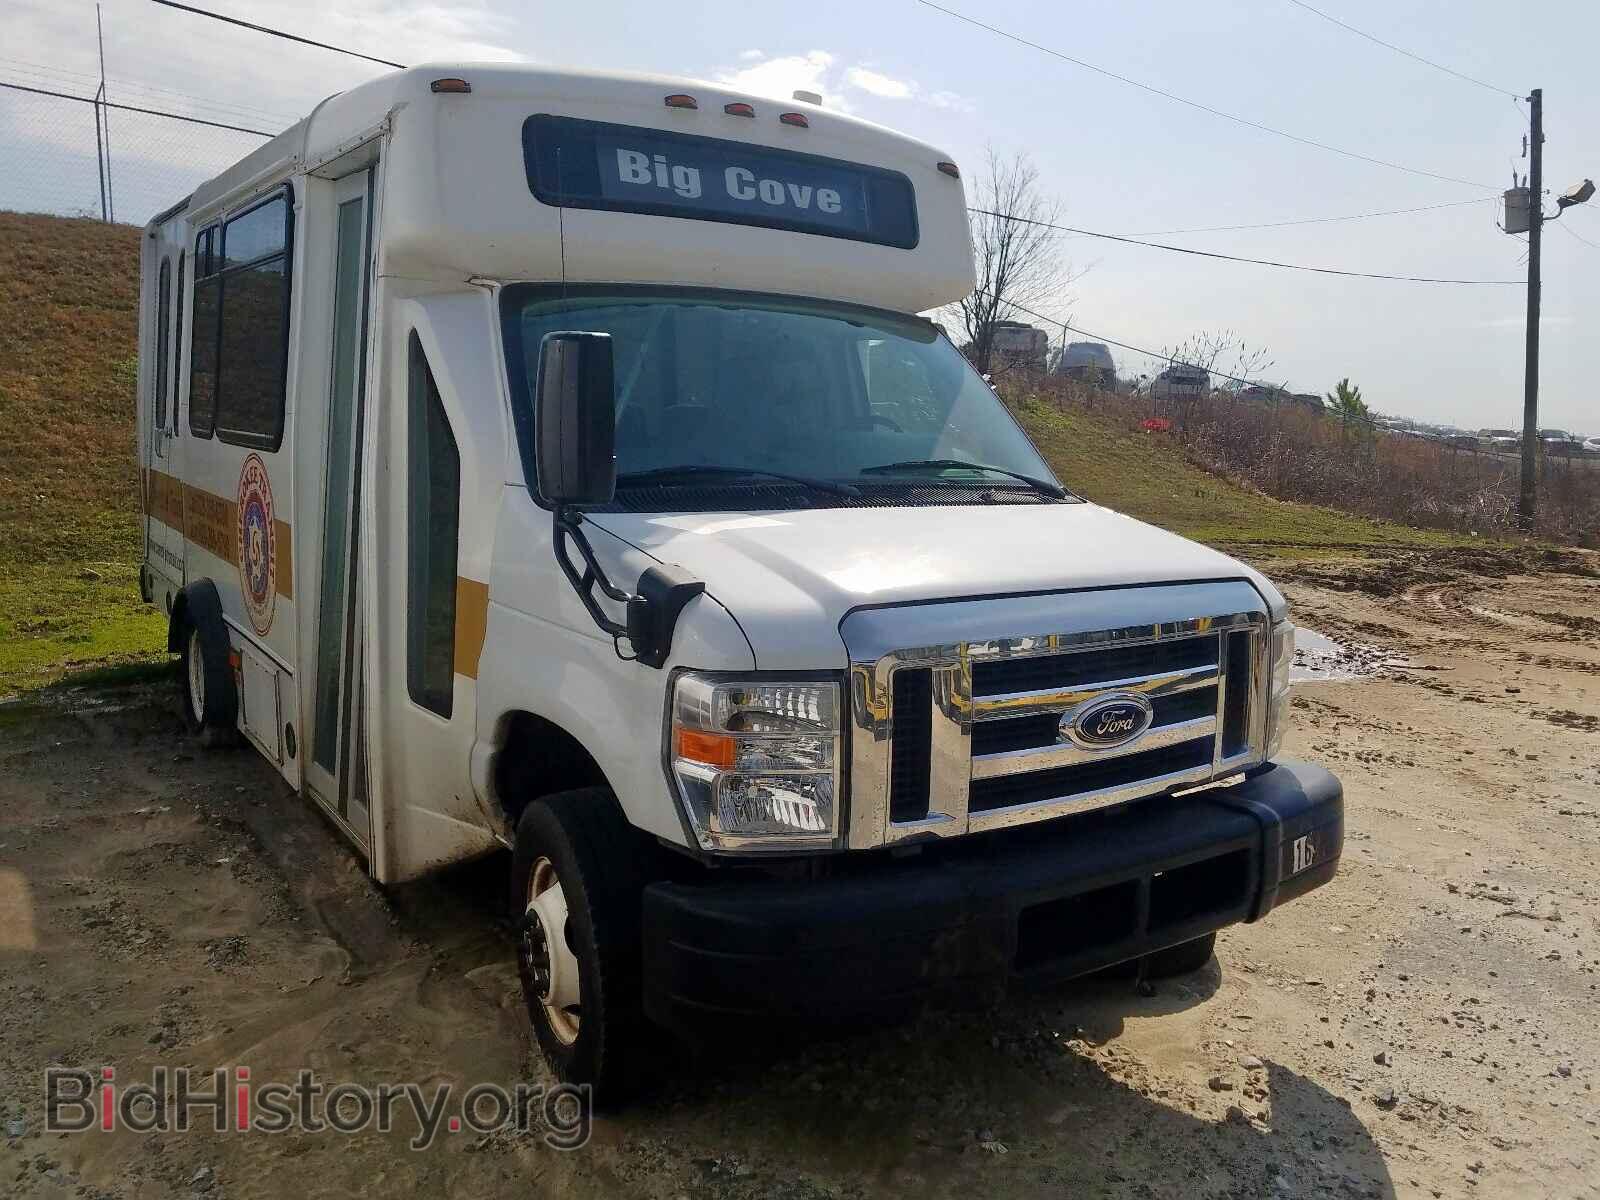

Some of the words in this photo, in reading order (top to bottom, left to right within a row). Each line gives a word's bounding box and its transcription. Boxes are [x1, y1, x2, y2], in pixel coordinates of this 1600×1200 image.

[616, 148, 702, 199] Big
[725, 166, 842, 214] Cove
[1096, 709, 1136, 735] Ford
